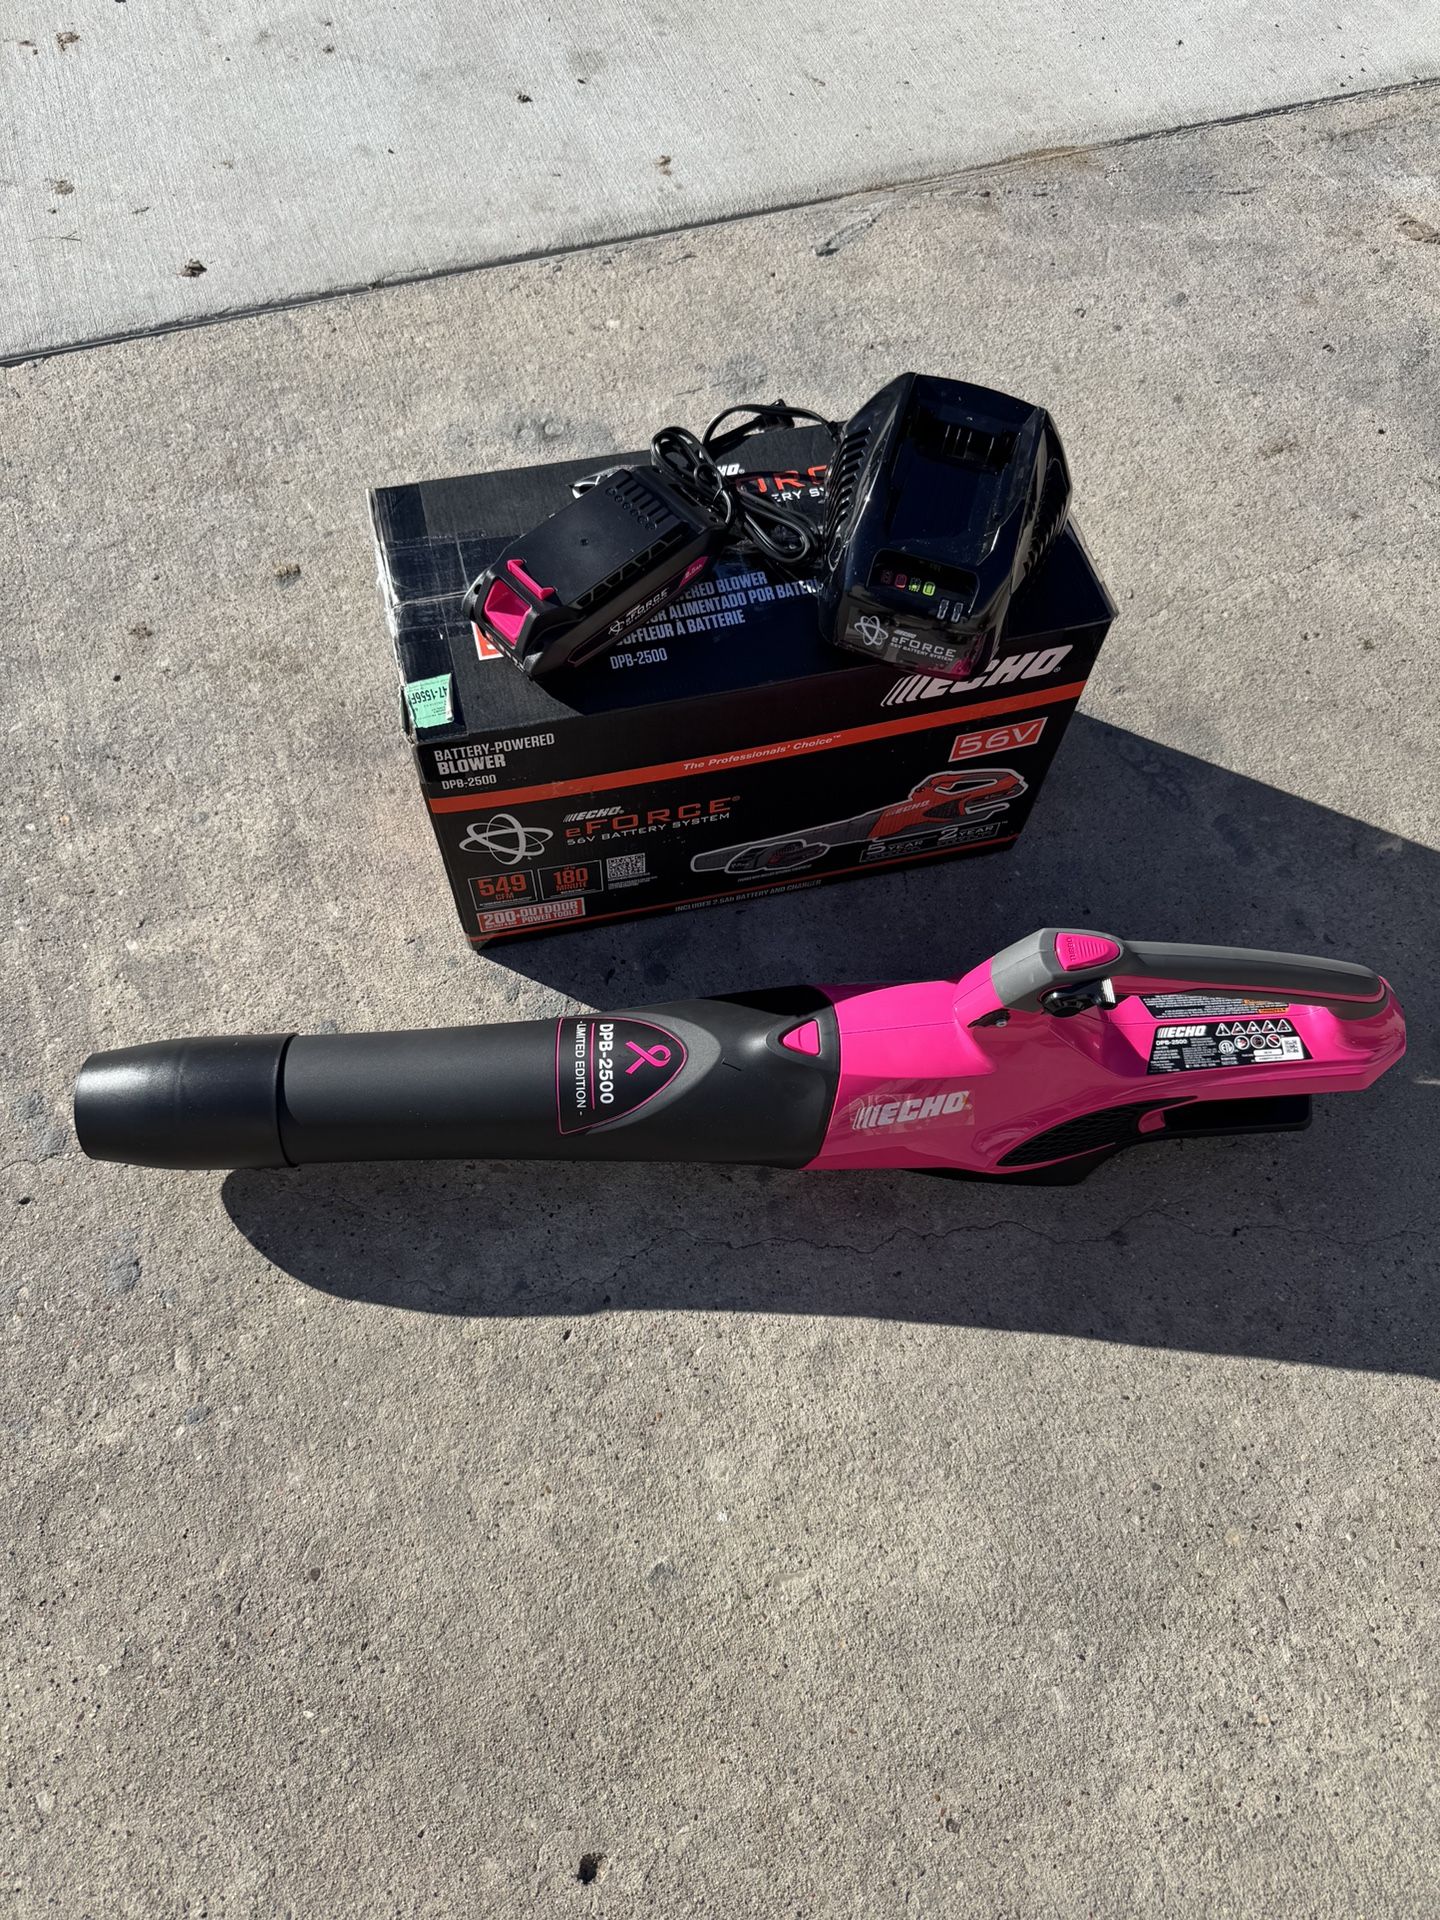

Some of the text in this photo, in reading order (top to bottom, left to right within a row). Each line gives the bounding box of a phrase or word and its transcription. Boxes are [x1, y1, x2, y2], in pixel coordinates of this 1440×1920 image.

[715, 570, 769, 593] BLOWER
[669, 591, 748, 620] ALIMENTADO
[747, 586, 776, 605] POR
[676, 619, 687, 637] À
[686, 608, 746, 633] BATTERIE
[609, 647, 668, 670] DPB-2500
[891, 635, 957, 659] eFORCE
[433, 733, 555, 762] BATTERY-POWERED
[958, 723, 1039, 755] 56V
[436, 753, 507, 776] BLOWER
[682, 762, 705, 771] The
[708, 744, 791, 766] Professionals'
[441, 774, 498, 790] DPB-2500
[567, 812, 731, 846] 56V BATTERY SYSTEM
[938, 826, 959, 841] 2
[960, 825, 996, 836] YEAR
[866, 840, 885, 855] 5
[887, 839, 924, 850] YEAR
[478, 873, 527, 897] 549
[553, 866, 589, 885] 180
[555, 882, 589, 892] MINUTE
[495, 892, 514, 901] CFM
[674, 900, 711, 912] INCLUDES
[735, 890, 769, 902] BATTERY
[769, 886, 786, 895] AND
[786, 879, 822, 892] CHARGER
[519, 901, 579, 917] OUTDOOR
[522, 908, 579, 924] POWER TOOLS
[1167, 1025, 1207, 1039] ECHO
[599, 1023, 614, 1104] DPB-2500
[575, 1060, 587, 1109] EDITION
[877, 1090, 970, 1127] ECHO
